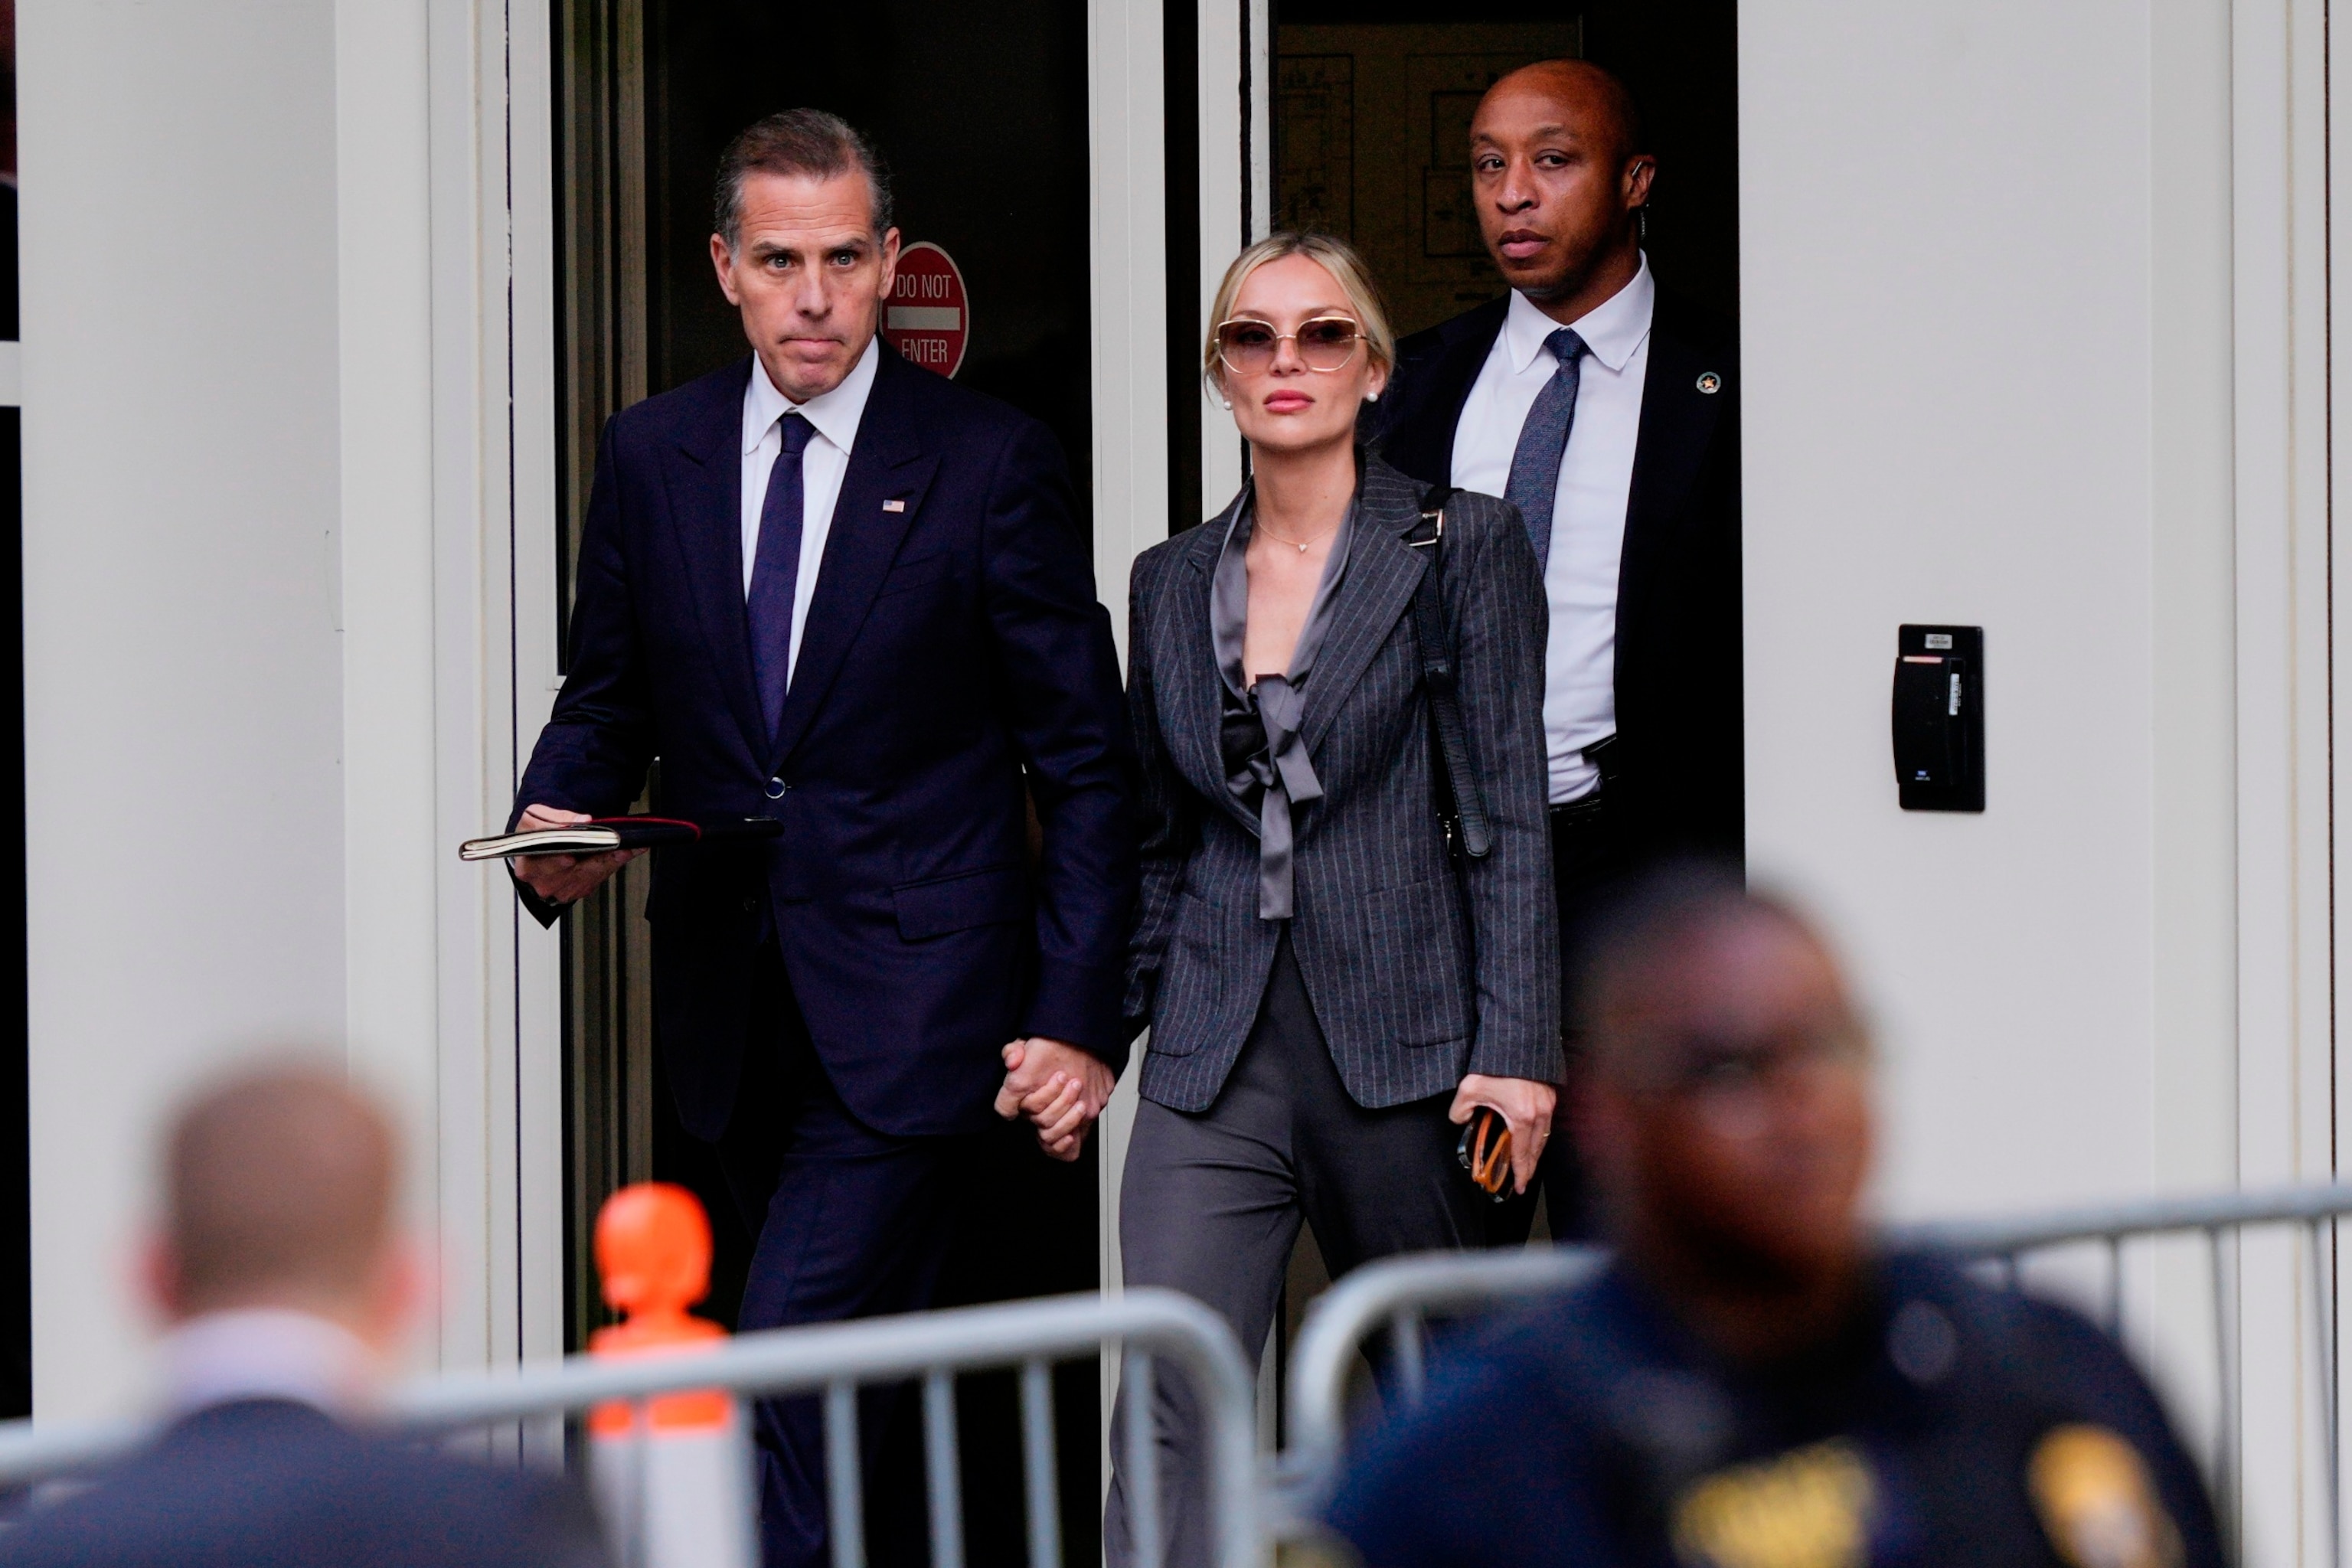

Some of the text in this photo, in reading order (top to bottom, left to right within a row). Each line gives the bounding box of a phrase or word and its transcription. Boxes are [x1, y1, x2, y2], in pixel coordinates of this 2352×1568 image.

[897, 274, 952, 299] DO NOT
[901, 338, 948, 363] ENTER
